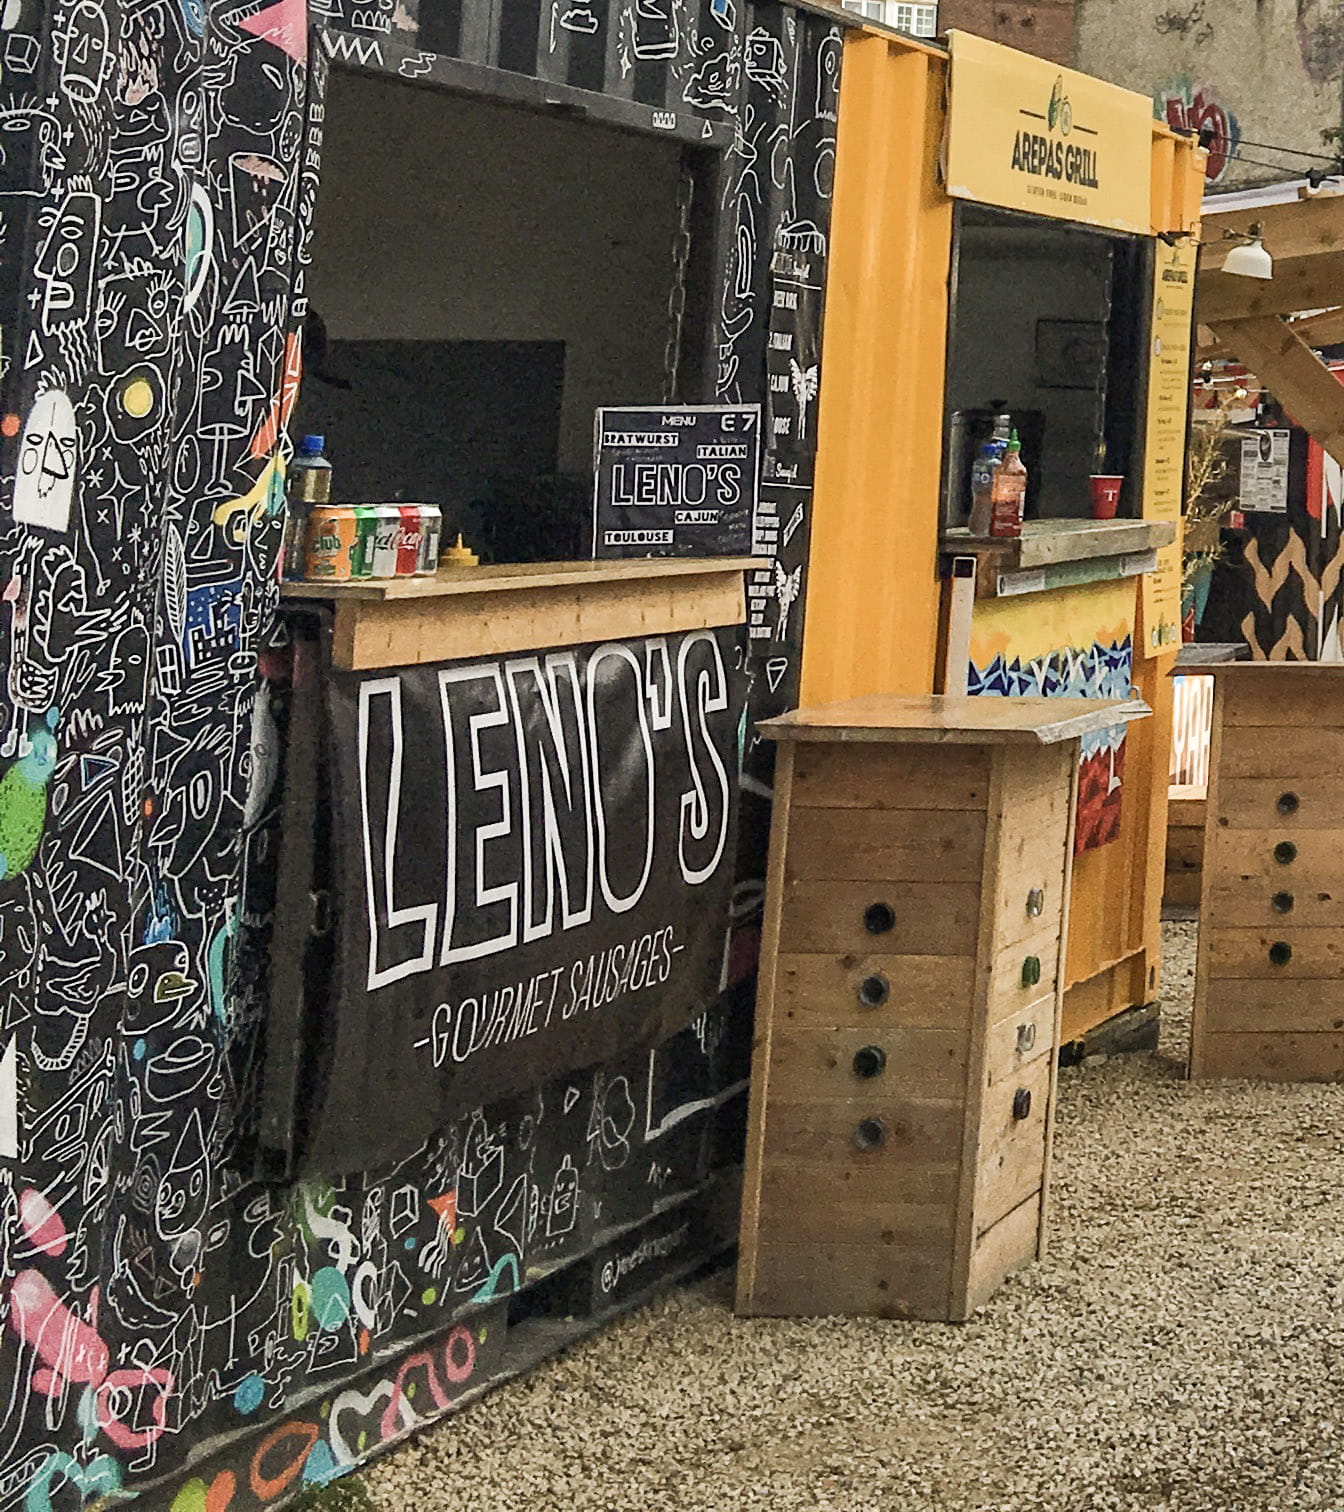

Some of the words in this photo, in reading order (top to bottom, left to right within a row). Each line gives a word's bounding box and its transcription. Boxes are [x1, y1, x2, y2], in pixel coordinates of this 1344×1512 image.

[1011, 129, 1063, 180] AREPAS
[1065, 144, 1099, 189] GRILL
[662, 416, 697, 426] MENU
[605, 434, 678, 445] BRATWURST
[698, 446, 746, 457] ITALIAN
[611, 464, 741, 506] LENO'S
[676, 512, 718, 522] CAJUN
[606, 532, 670, 543] TOULOUSE
[359, 629, 730, 991] LENO'S
